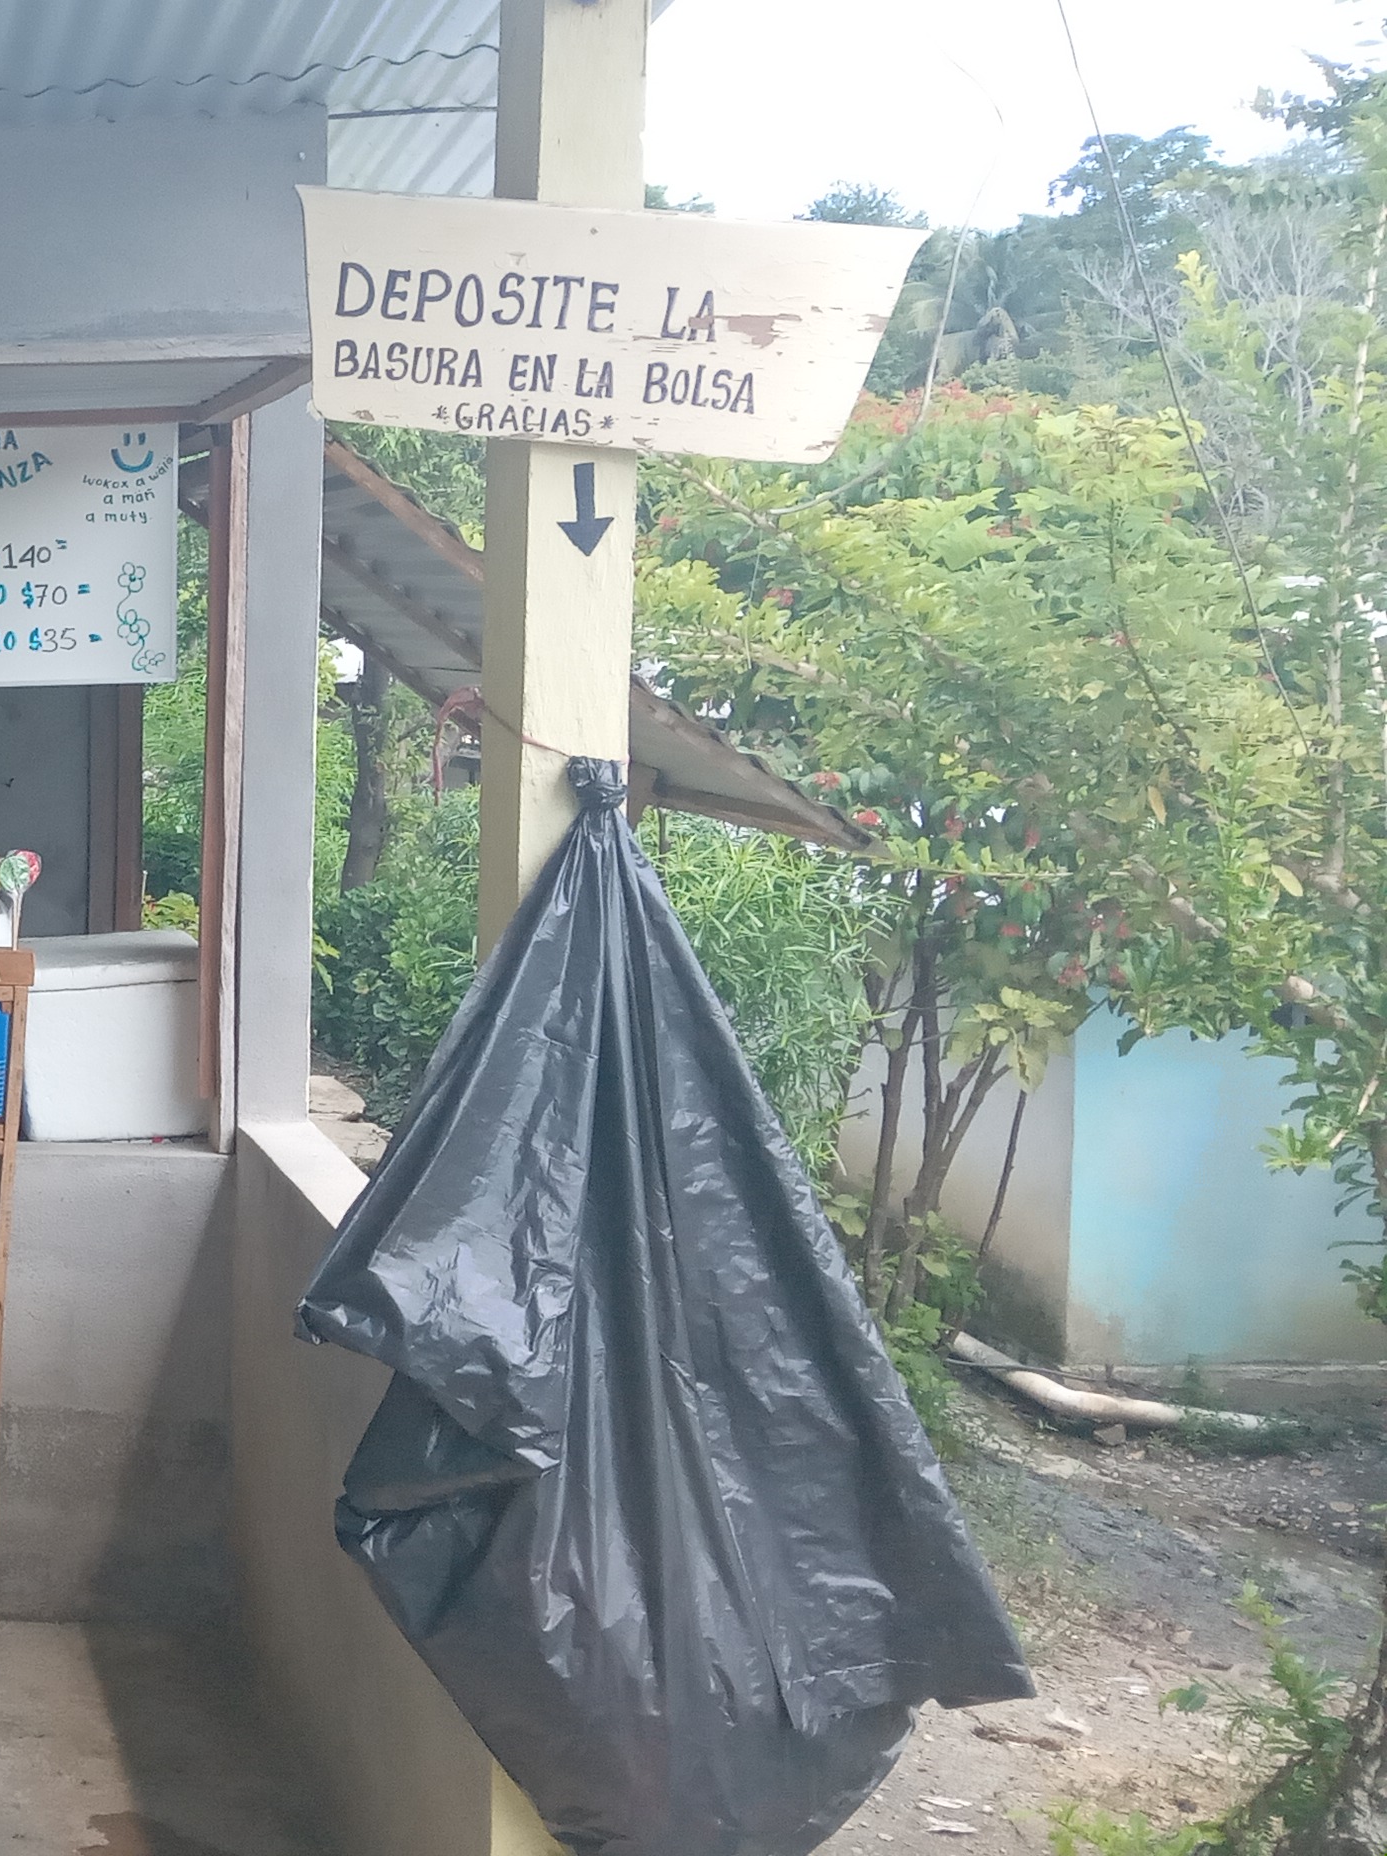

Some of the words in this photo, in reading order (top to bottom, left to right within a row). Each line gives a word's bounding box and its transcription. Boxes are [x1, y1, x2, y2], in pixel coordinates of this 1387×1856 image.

[335, 262, 620, 335] DEPOSITE
[661, 286, 718, 343] LA
[334, 339, 484, 390] BASURA
[509, 353, 557, 394] EN
[576, 357, 615, 400] LA
[643, 362, 756, 416] BOLSA
[85, 512, 95, 523] a
[103, 494, 114, 505] a
